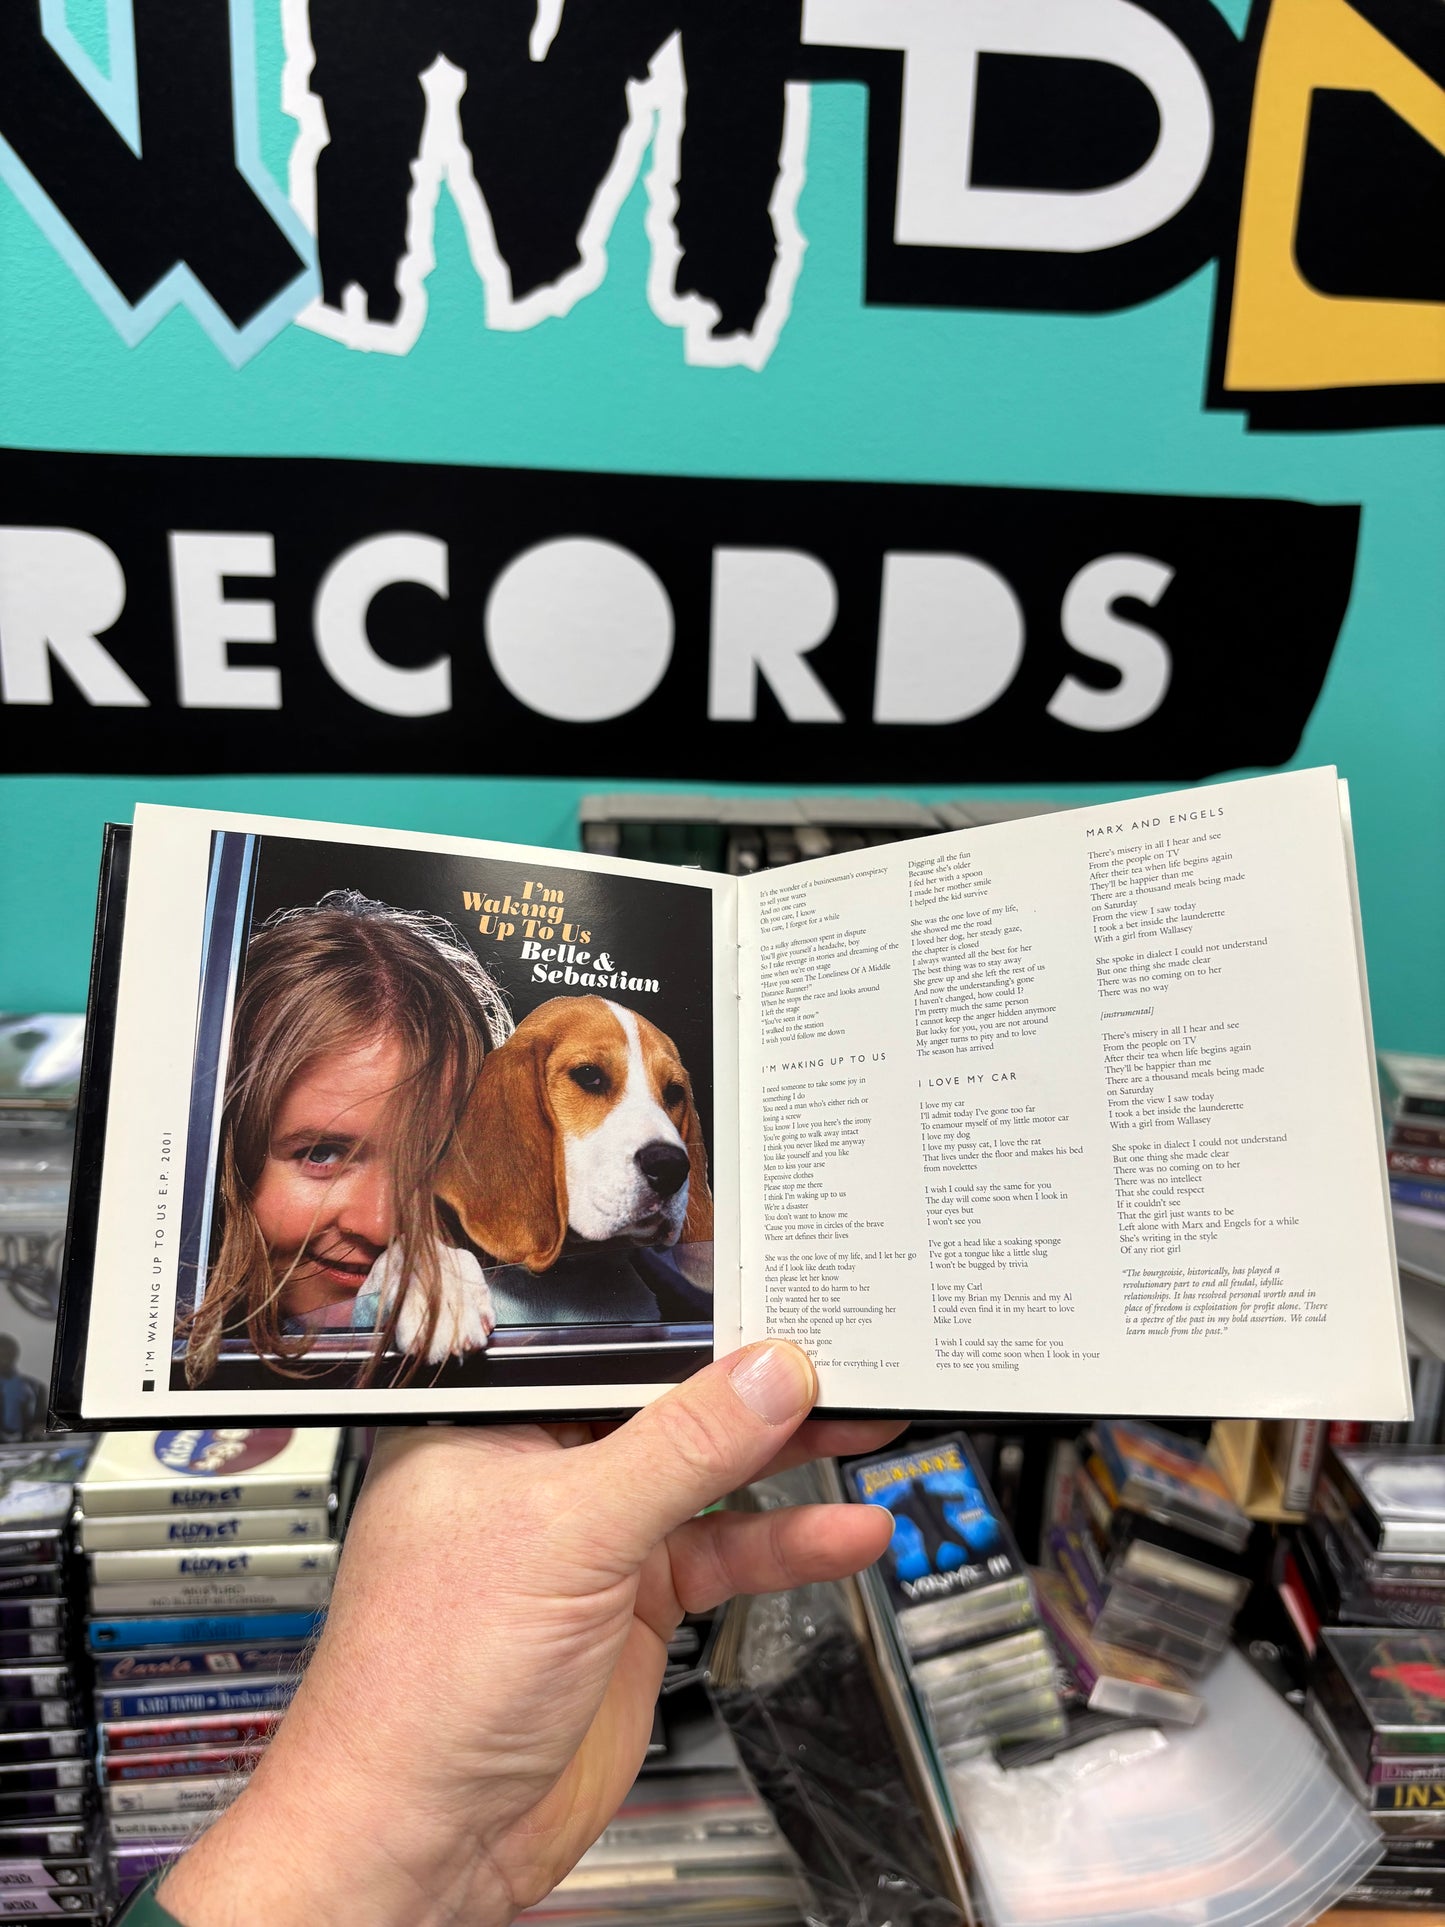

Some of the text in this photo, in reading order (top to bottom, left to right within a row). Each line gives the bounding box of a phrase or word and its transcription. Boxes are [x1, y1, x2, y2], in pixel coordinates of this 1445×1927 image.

[0, 526, 1176, 731] RECORDS
[1086, 807, 1224, 838] MARX AND ENGELS
[1087, 848, 1115, 859] There's
[1117, 846, 1143, 855] misery
[1154, 840, 1164, 849] all
[1172, 838, 1190, 846] hear
[1192, 833, 1207, 843] and
[908, 858, 935, 869] Digging
[936, 855, 945, 863] all
[959, 851, 971, 859] fun
[1088, 862, 1110, 870] From
[1111, 858, 1124, 866] the
[1126, 854, 1152, 867] people
[1166, 848, 1180, 858] TV
[521, 880, 564, 904] I'm
[1090, 892, 1113, 901] There
[1135, 882, 1172, 895] thousand
[1173, 879, 1196, 889] meals
[1198, 877, 1222, 886] being
[1223, 873, 1245, 882] made
[462, 891, 564, 924] Waking
[1104, 899, 1138, 910] Saturday
[479, 915, 592, 944] Up To Us
[1094, 934, 1114, 943] With
[1122, 931, 1136, 943] girl
[1137, 930, 1157, 938] from
[1159, 926, 1193, 935] Wallasey
[520, 941, 615, 971] Belle &
[1096, 957, 1110, 965] She
[1112, 954, 1134, 965] spoke
[1146, 950, 1172, 959] dialect
[1180, 944, 1203, 955] could
[1222, 937, 1268, 950] understand
[531, 963, 660, 992] Sebastian
[920, 1018, 943, 1026] cannot
[945, 1016, 961, 1026] keep
[962, 1013, 974, 1021] the
[975, 1012, 996, 1021] anger
[997, 1008, 1023, 1017] hidden
[1024, 1006, 1056, 1017] anymore
[1100, 1006, 1154, 1021] [instrumental]
[916, 1049, 930, 1057] The
[955, 1045, 968, 1053] has
[969, 1042, 995, 1052] arrived
[781, 1059, 824, 1070] WAKING
[830, 1056, 844, 1066] UP
[850, 1054, 866, 1063] TO
[872, 1052, 886, 1061] US
[928, 1076, 960, 1087] LOVE
[967, 1075, 984, 1084] MY
[991, 1072, 1017, 1082] CAR
[920, 1122, 931, 1130] To
[931, 1122, 963, 1130] enamour
[965, 1118, 988, 1129] myself
[989, 1117, 998, 1126] of
[999, 1119, 1012, 1127] my
[1013, 1116, 1030, 1124] little
[923, 1163, 978, 1172] from novelettes
[1118, 1222, 1136, 1231] Left
[1137, 1222, 1159, 1230] alone
[1161, 1221, 1180, 1230] with
[1182, 1220, 1204, 1229] Marx
[1205, 1219, 1221, 1228] and
[1223, 1218, 1252, 1230] Engels
[1253, 1218, 1266, 1226] for
[1276, 1216, 1299, 1225] while
[764, 1233, 784, 1241] Where
[794, 1232, 817, 1240] defines
[818, 1231, 833, 1239] their
[834, 1231, 849, 1239] lives
[928, 1239, 942, 1248] I've
[943, 1241, 956, 1249] got
[963, 1238, 981, 1247] head
[982, 1238, 996, 1246] like
[1003, 1237, 1033, 1248] soaking
[1034, 1238, 1061, 1247] sponge
[1119, 1231, 1218, 1244] She's writing in the style
[145, 1132, 171, 1372] I'M WAKING UP TO US E.P. 2001
[1120, 1245, 1131, 1254] Of
[1133, 1248, 1148, 1256] any
[1167, 1244, 1181, 1255] girl
[935, 1261, 956, 1269] won't
[957, 1260, 966, 1268] be
[968, 1260, 996, 1271] bugged
[997, 1260, 1007, 1270] by
[1008, 1260, 1029, 1268] trivia
[1123, 1280, 1172, 1291] revolutionary
[1173, 1281, 1190, 1290] part
[1201, 1278, 1216, 1287] end
[1217, 1278, 1229, 1287] all
[1230, 1278, 1258, 1289] feudal,
[1260, 1277, 1284, 1289] idyllic
[766, 1314, 872, 1326] But when she opened up her eyes
[933, 1316, 972, 1324] Mike Love
[935, 1363, 951, 1371] eyes
[975, 1363, 990, 1371] you
[991, 1361, 1020, 1372] smiling
